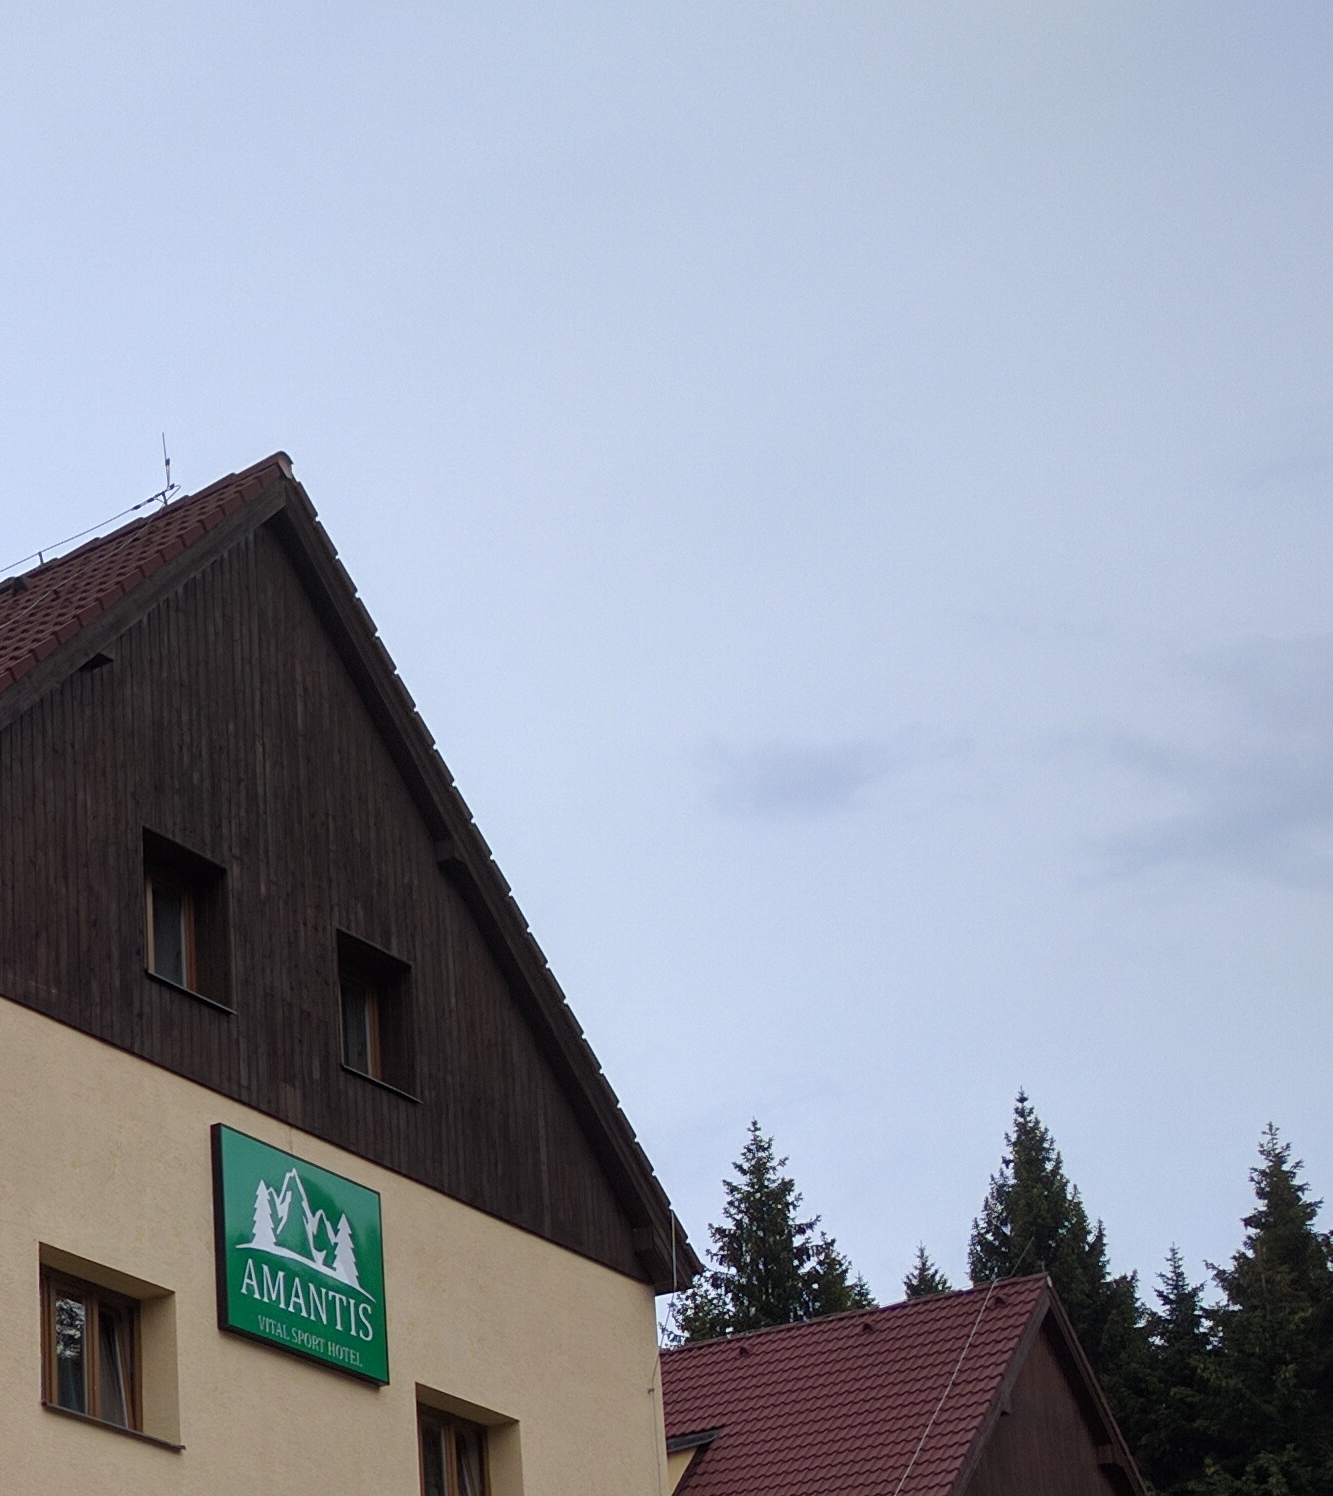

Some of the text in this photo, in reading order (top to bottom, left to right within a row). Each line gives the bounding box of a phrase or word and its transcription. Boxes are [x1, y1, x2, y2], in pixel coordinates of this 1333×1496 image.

[240, 1258, 374, 1341] AMANTIS
[258, 1315, 363, 1368] VITAL SPORT HOTEL
